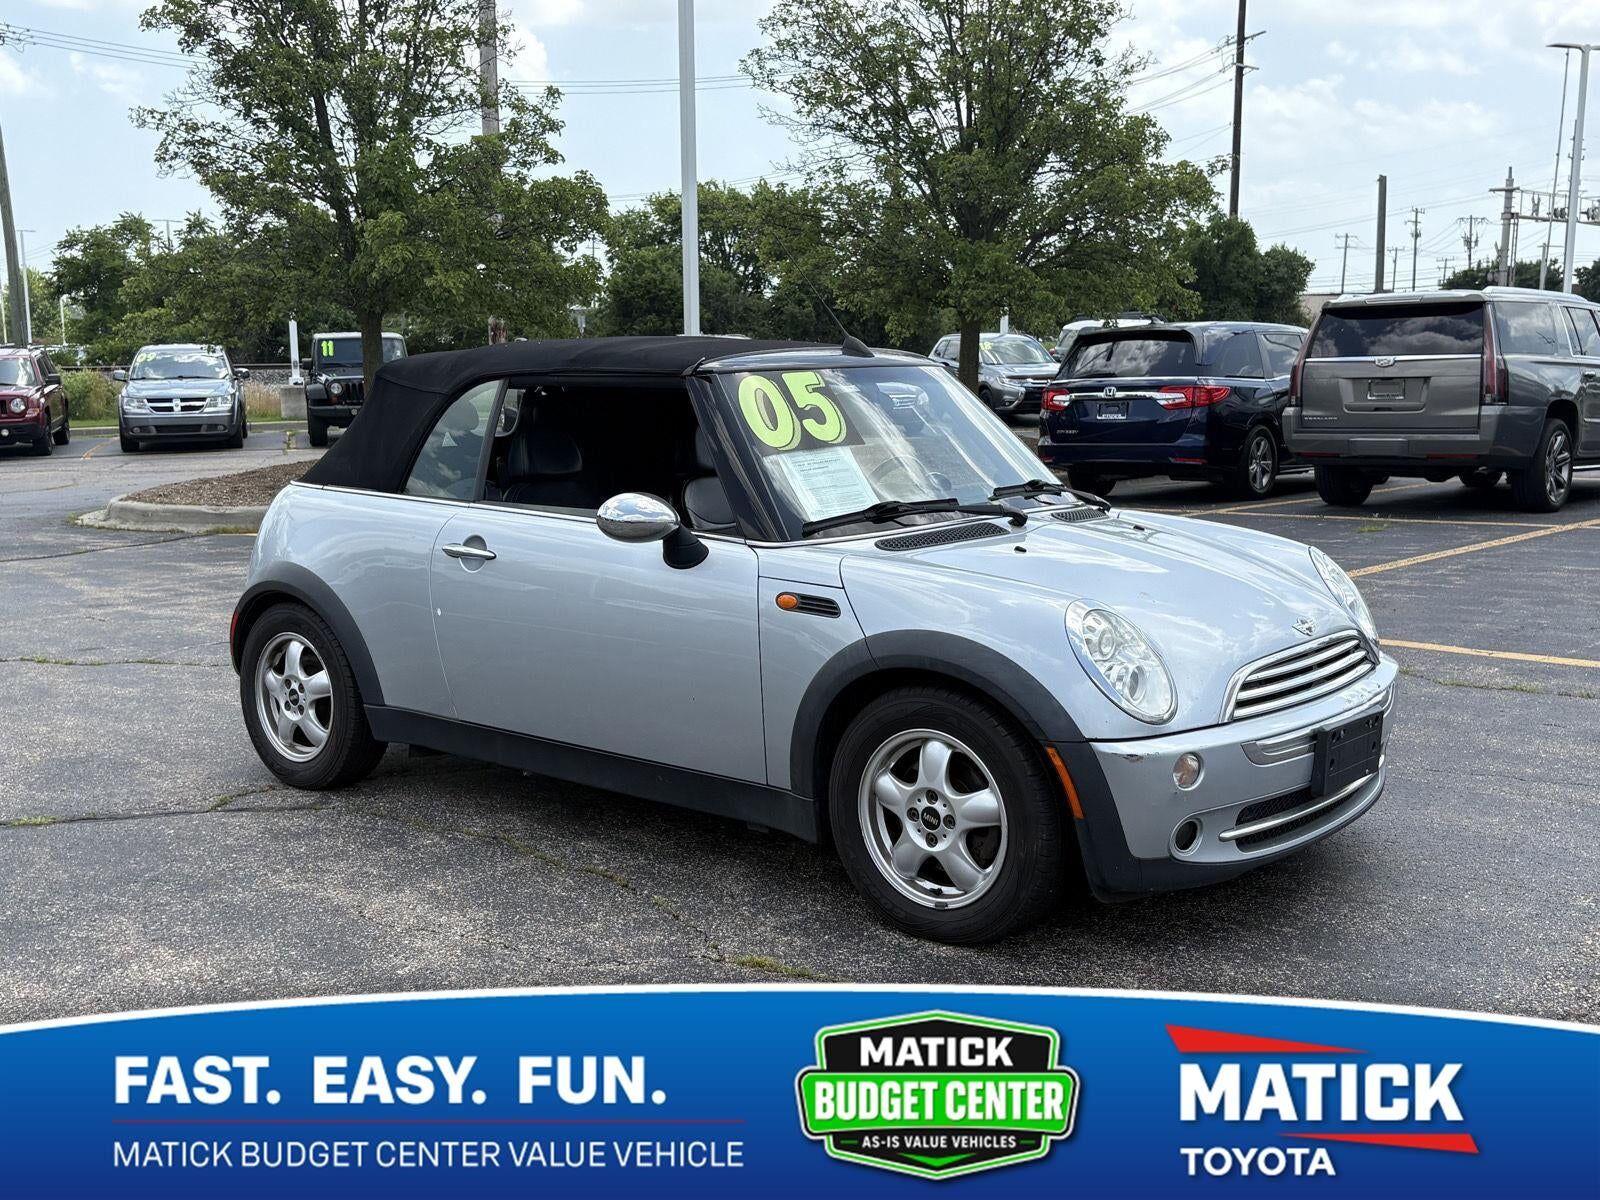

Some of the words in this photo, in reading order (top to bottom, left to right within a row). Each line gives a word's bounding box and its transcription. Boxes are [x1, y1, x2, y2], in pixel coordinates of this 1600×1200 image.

[321, 340, 334, 357] 11
[738, 371, 847, 451] 05
[922, 812, 939, 826] MINI
